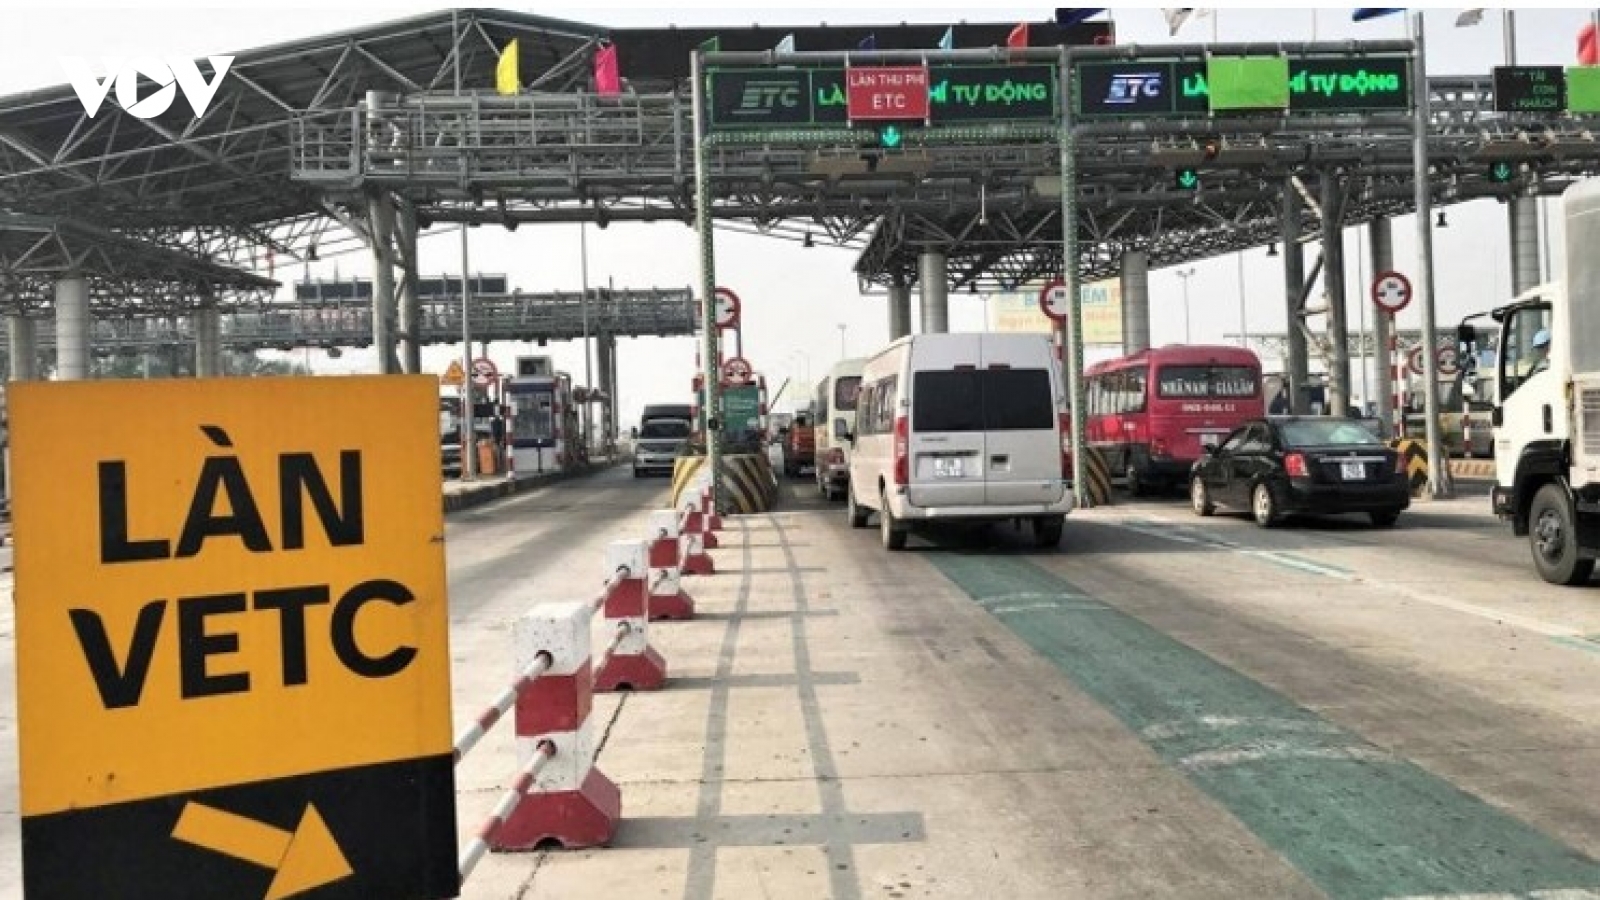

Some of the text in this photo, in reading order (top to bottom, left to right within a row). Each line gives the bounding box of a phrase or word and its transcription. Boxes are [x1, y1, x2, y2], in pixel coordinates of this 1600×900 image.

[850, 72, 876, 86] LÀN
[878, 74, 902, 86] THU
[1106, 74, 1162, 102] ETC
[1182, 74, 1208, 96] LÀ
[741, 82, 799, 108] ETC
[818, 83, 847, 105] LÀ
[952, 85, 980, 106] TỰ
[985, 79, 1048, 105] ĐỘNG
[873, 93, 906, 110] ETC
[98, 425, 365, 564] LÀN
[68, 578, 419, 709] VETC
